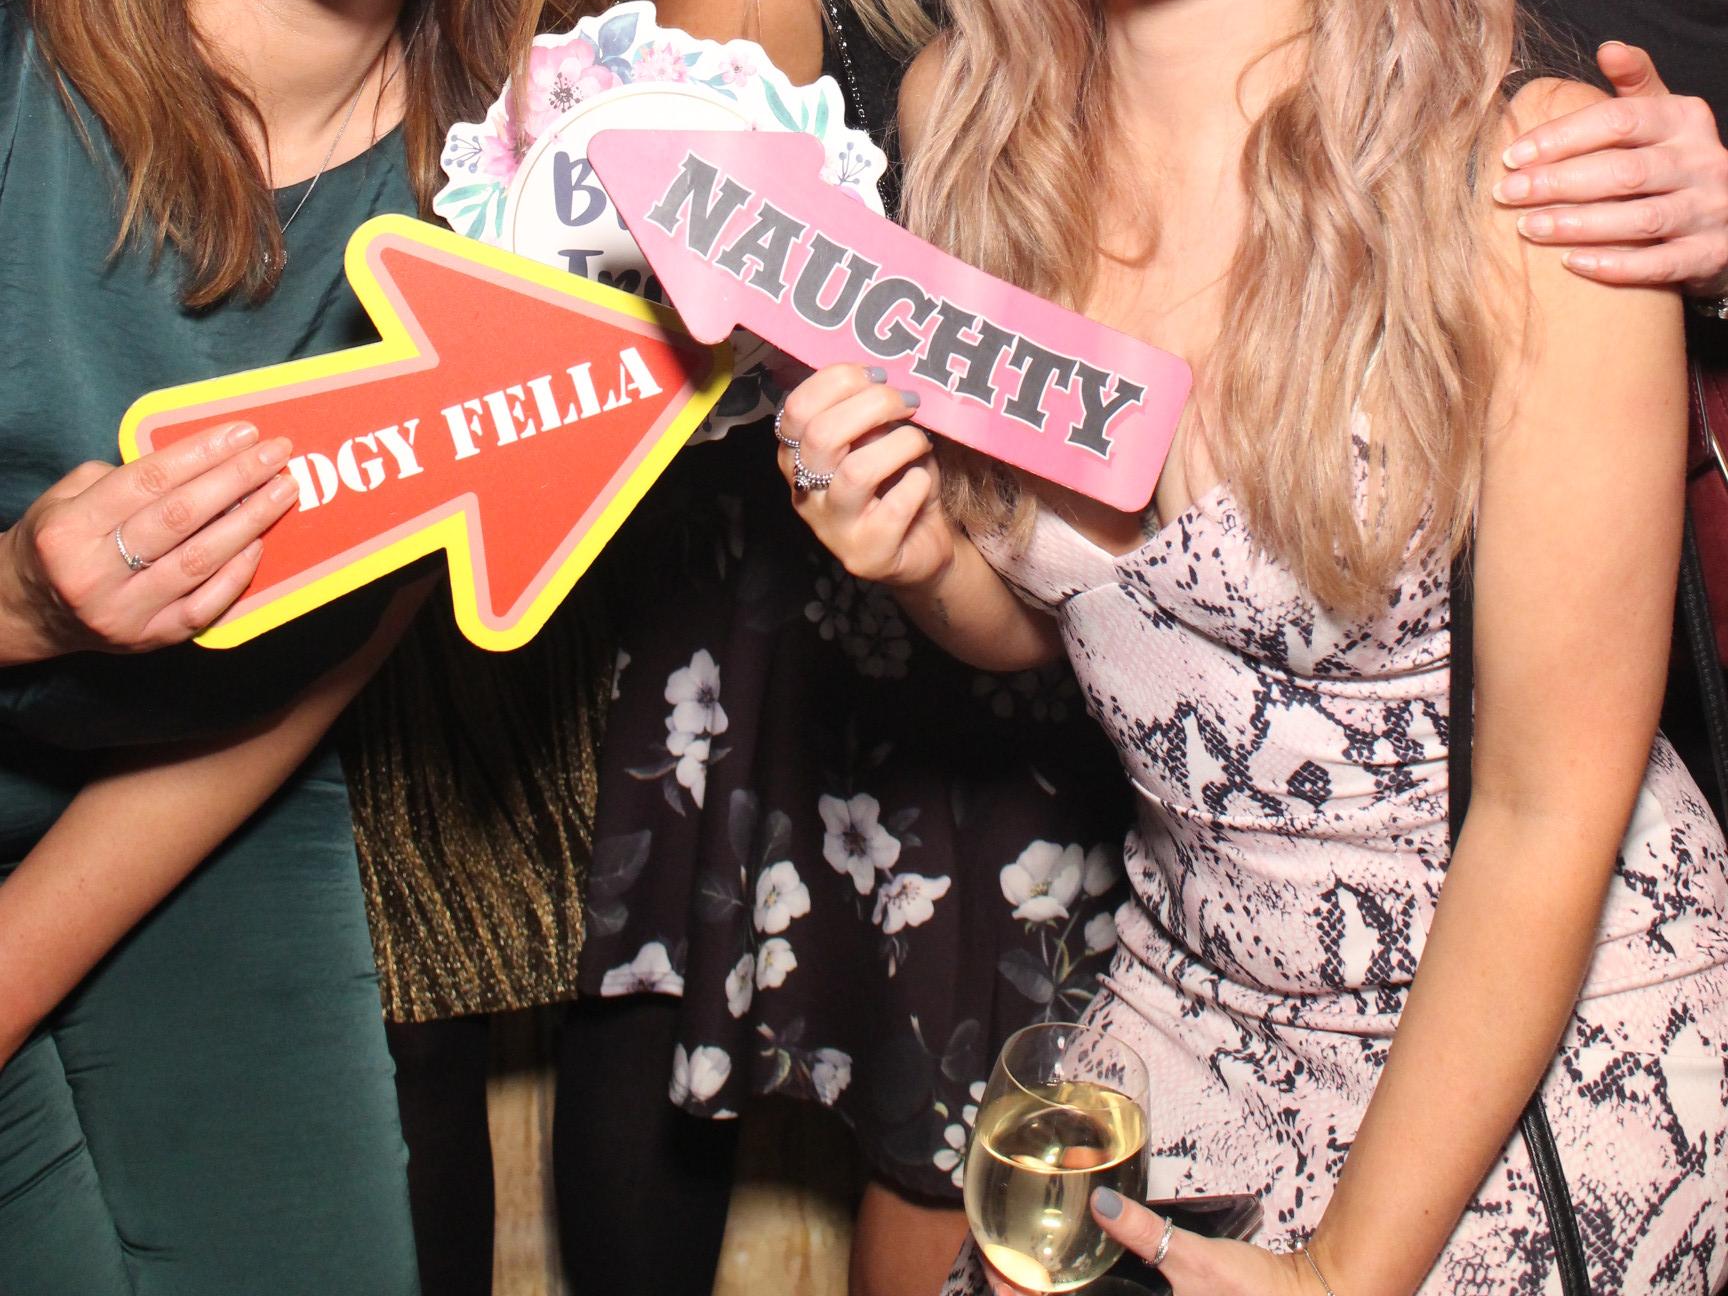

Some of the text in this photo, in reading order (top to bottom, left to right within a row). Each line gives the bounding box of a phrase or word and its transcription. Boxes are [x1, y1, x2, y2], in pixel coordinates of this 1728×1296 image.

[645, 149, 1146, 461] NAUGHTY
[286, 346, 663, 513] DGY FELLA
